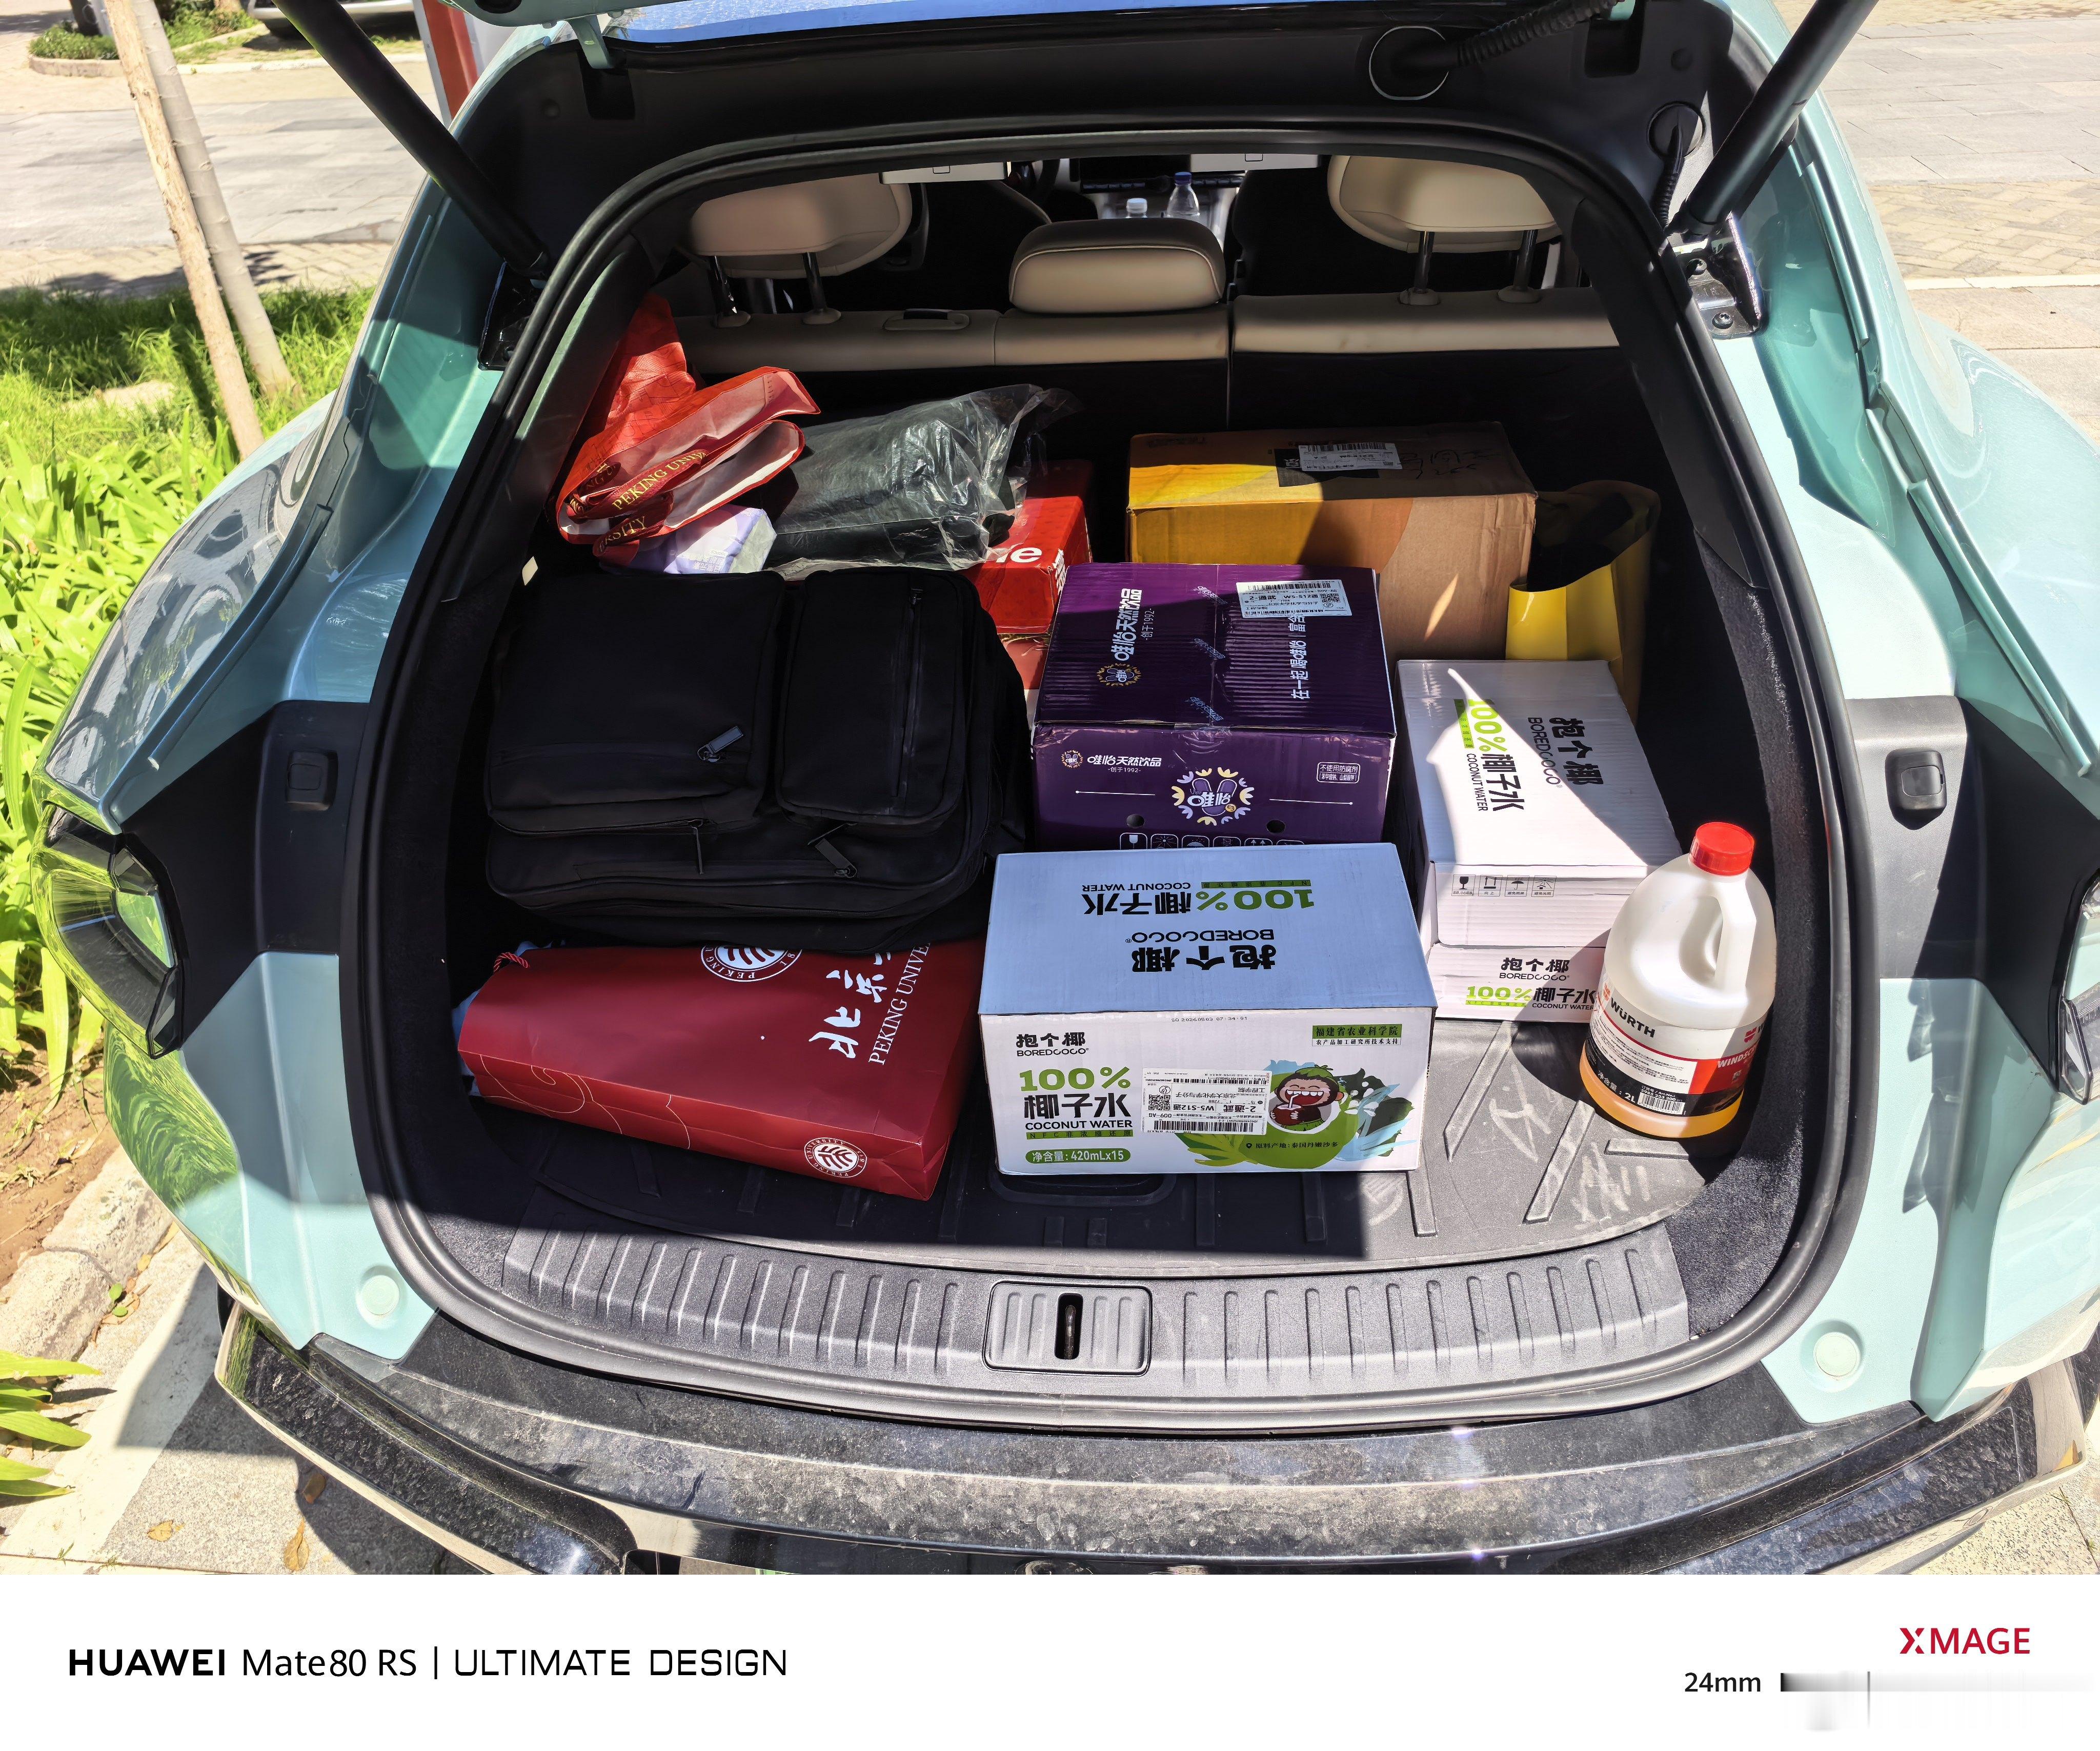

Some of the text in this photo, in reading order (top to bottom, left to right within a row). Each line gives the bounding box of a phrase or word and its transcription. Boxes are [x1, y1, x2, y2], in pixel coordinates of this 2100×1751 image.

[613, 469, 668, 510] PEKING
[1110, 588, 1143, 661] 唯怡天然饮品
[1467, 699, 1508, 752] 100%
[1087, 755, 1162, 767] 唯怡天然饮品
[1549, 717, 1604, 785] 抱个椰
[1320, 764, 1358, 773] 不使用防腐剂
[1466, 753, 1488, 811] COCONUT WATER
[1480, 753, 1525, 811] 椰子水
[1187, 791, 1231, 807] 唯怡
[1082, 882, 1191, 892] COCONUT WATER
[1081, 891, 1191, 915] 椰子水
[1196, 889, 1315, 911] 100%
[1132, 944, 1276, 972] 抱个椰
[1501, 957, 1570, 973] 抱个椰
[1466, 986, 1532, 1002] 100%
[1533, 987, 1597, 1004] 椰子水
[1611, 997, 1655, 1038] WÜRTH
[868, 998, 907, 1066] PEKING
[1016, 1032, 1086, 1048] 抱个椰
[1316, 1025, 1399, 1037] 福建省农业科学院
[1019, 1066, 1131, 1091] 100%
[1024, 1092, 1132, 1119] 椰子水
[1223, 1104, 1257, 1113] 2-通武
[1624, 1092, 1636, 1103] 2L
[1025, 1119, 1133, 1130] COCONUT WATER
